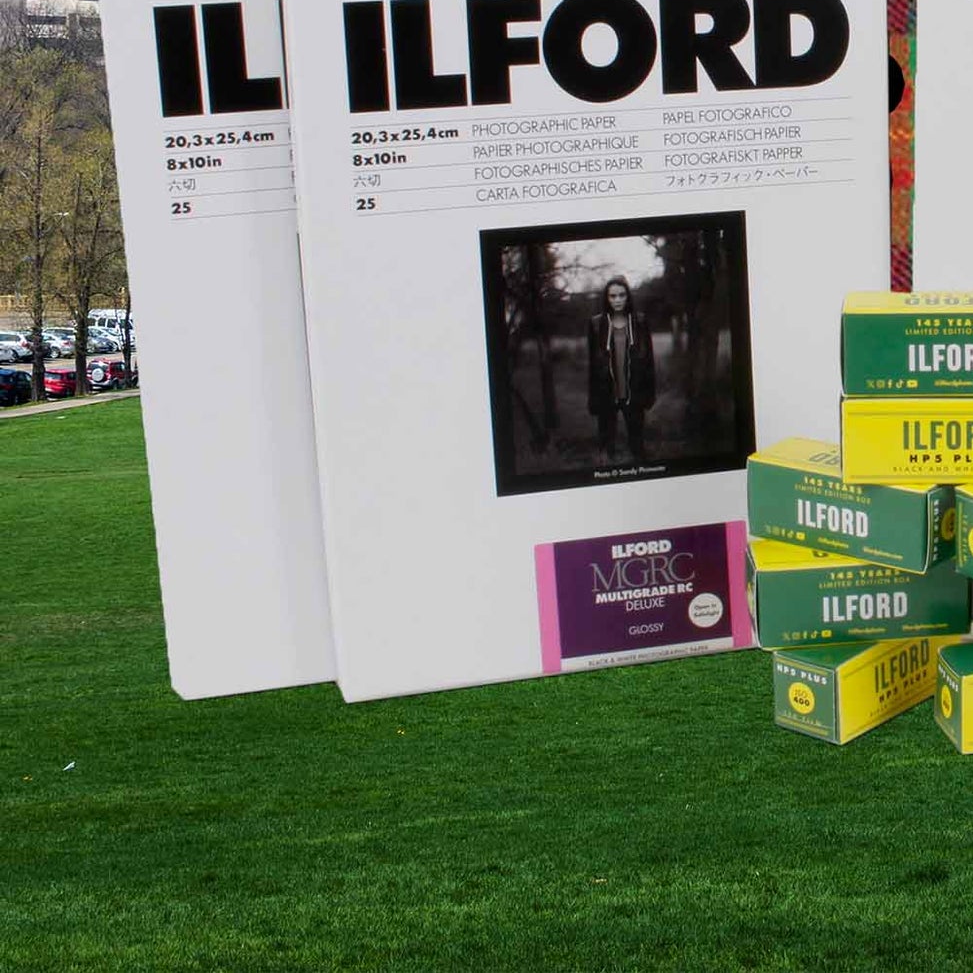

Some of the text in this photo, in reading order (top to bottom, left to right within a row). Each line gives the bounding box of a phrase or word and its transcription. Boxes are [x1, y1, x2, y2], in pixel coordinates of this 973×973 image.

[662, 104, 793, 126] PAPEL FOTOGRAFICO
[471, 116, 617, 137] PHOTOGRAPHIC PAPER
[663, 125, 802, 146] FOTOGRAFISCH PAPIER
[472, 135, 640, 159] PAPIER PHOTOGRAPHIQUE
[664, 146, 804, 168] FOTOGRAFISKT PAPPER
[166, 155, 223, 172] 8x10in
[352, 152, 407, 167] 8x10in
[474, 156, 644, 181] FOTOGRAPHISCHES PAPIER
[475, 179, 618, 203] CARTA FOTOGRAFICA
[171, 201, 192, 215] 25
[355, 198, 377, 211] 25
[904, 327, 939, 336] LIMITED
[909, 454, 942, 463] HP5
[796, 498, 869, 538] ILFORD
[611, 539, 673, 559] ILFORD
[589, 552, 696, 593] MGRC
[595, 582, 694, 604] MULTIGRADE RC
[625, 598, 666, 612] DELUXE
[822, 591, 908, 623] ILFORD
[628, 622, 665, 636] GLOSSY
[875, 638, 929, 694] ILFORD
[800, 670, 828, 686] PLUS
[792, 696, 810, 707] 400
